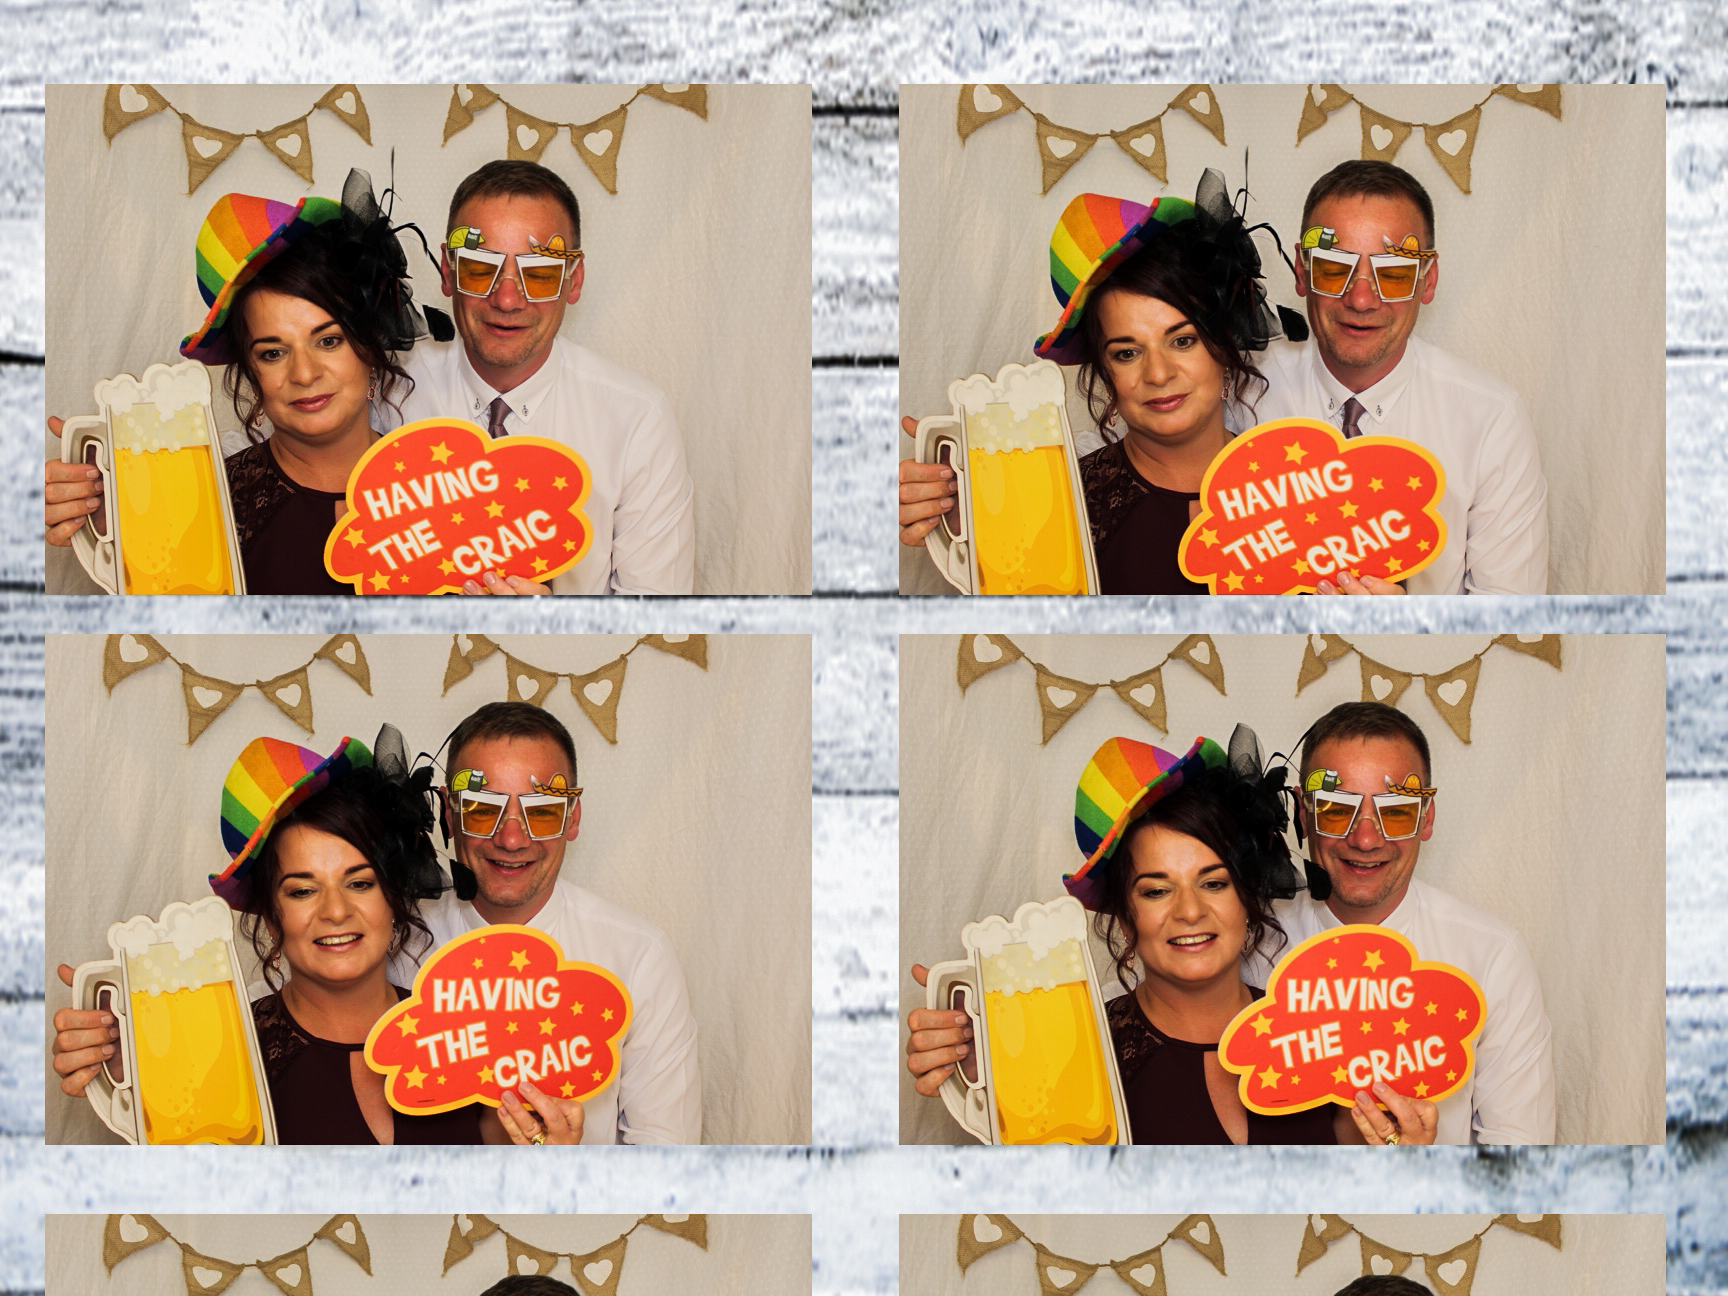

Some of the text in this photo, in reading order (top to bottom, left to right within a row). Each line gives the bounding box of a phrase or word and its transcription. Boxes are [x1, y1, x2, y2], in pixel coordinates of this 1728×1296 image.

[363, 460, 499, 521] HAVING
[1217, 460, 1353, 521] HAVING
[368, 519, 442, 569] THE
[453, 509, 556, 575] CRAIC
[1222, 519, 1296, 569] THE
[1307, 509, 1410, 575] CRAIC
[433, 977, 560, 1013] HAVING
[1287, 977, 1414, 1013] HAVING
[416, 1021, 489, 1068] THE
[494, 1035, 592, 1087] CRAIC
[1270, 1021, 1343, 1068] THE
[1348, 1035, 1446, 1087] CRAIC
